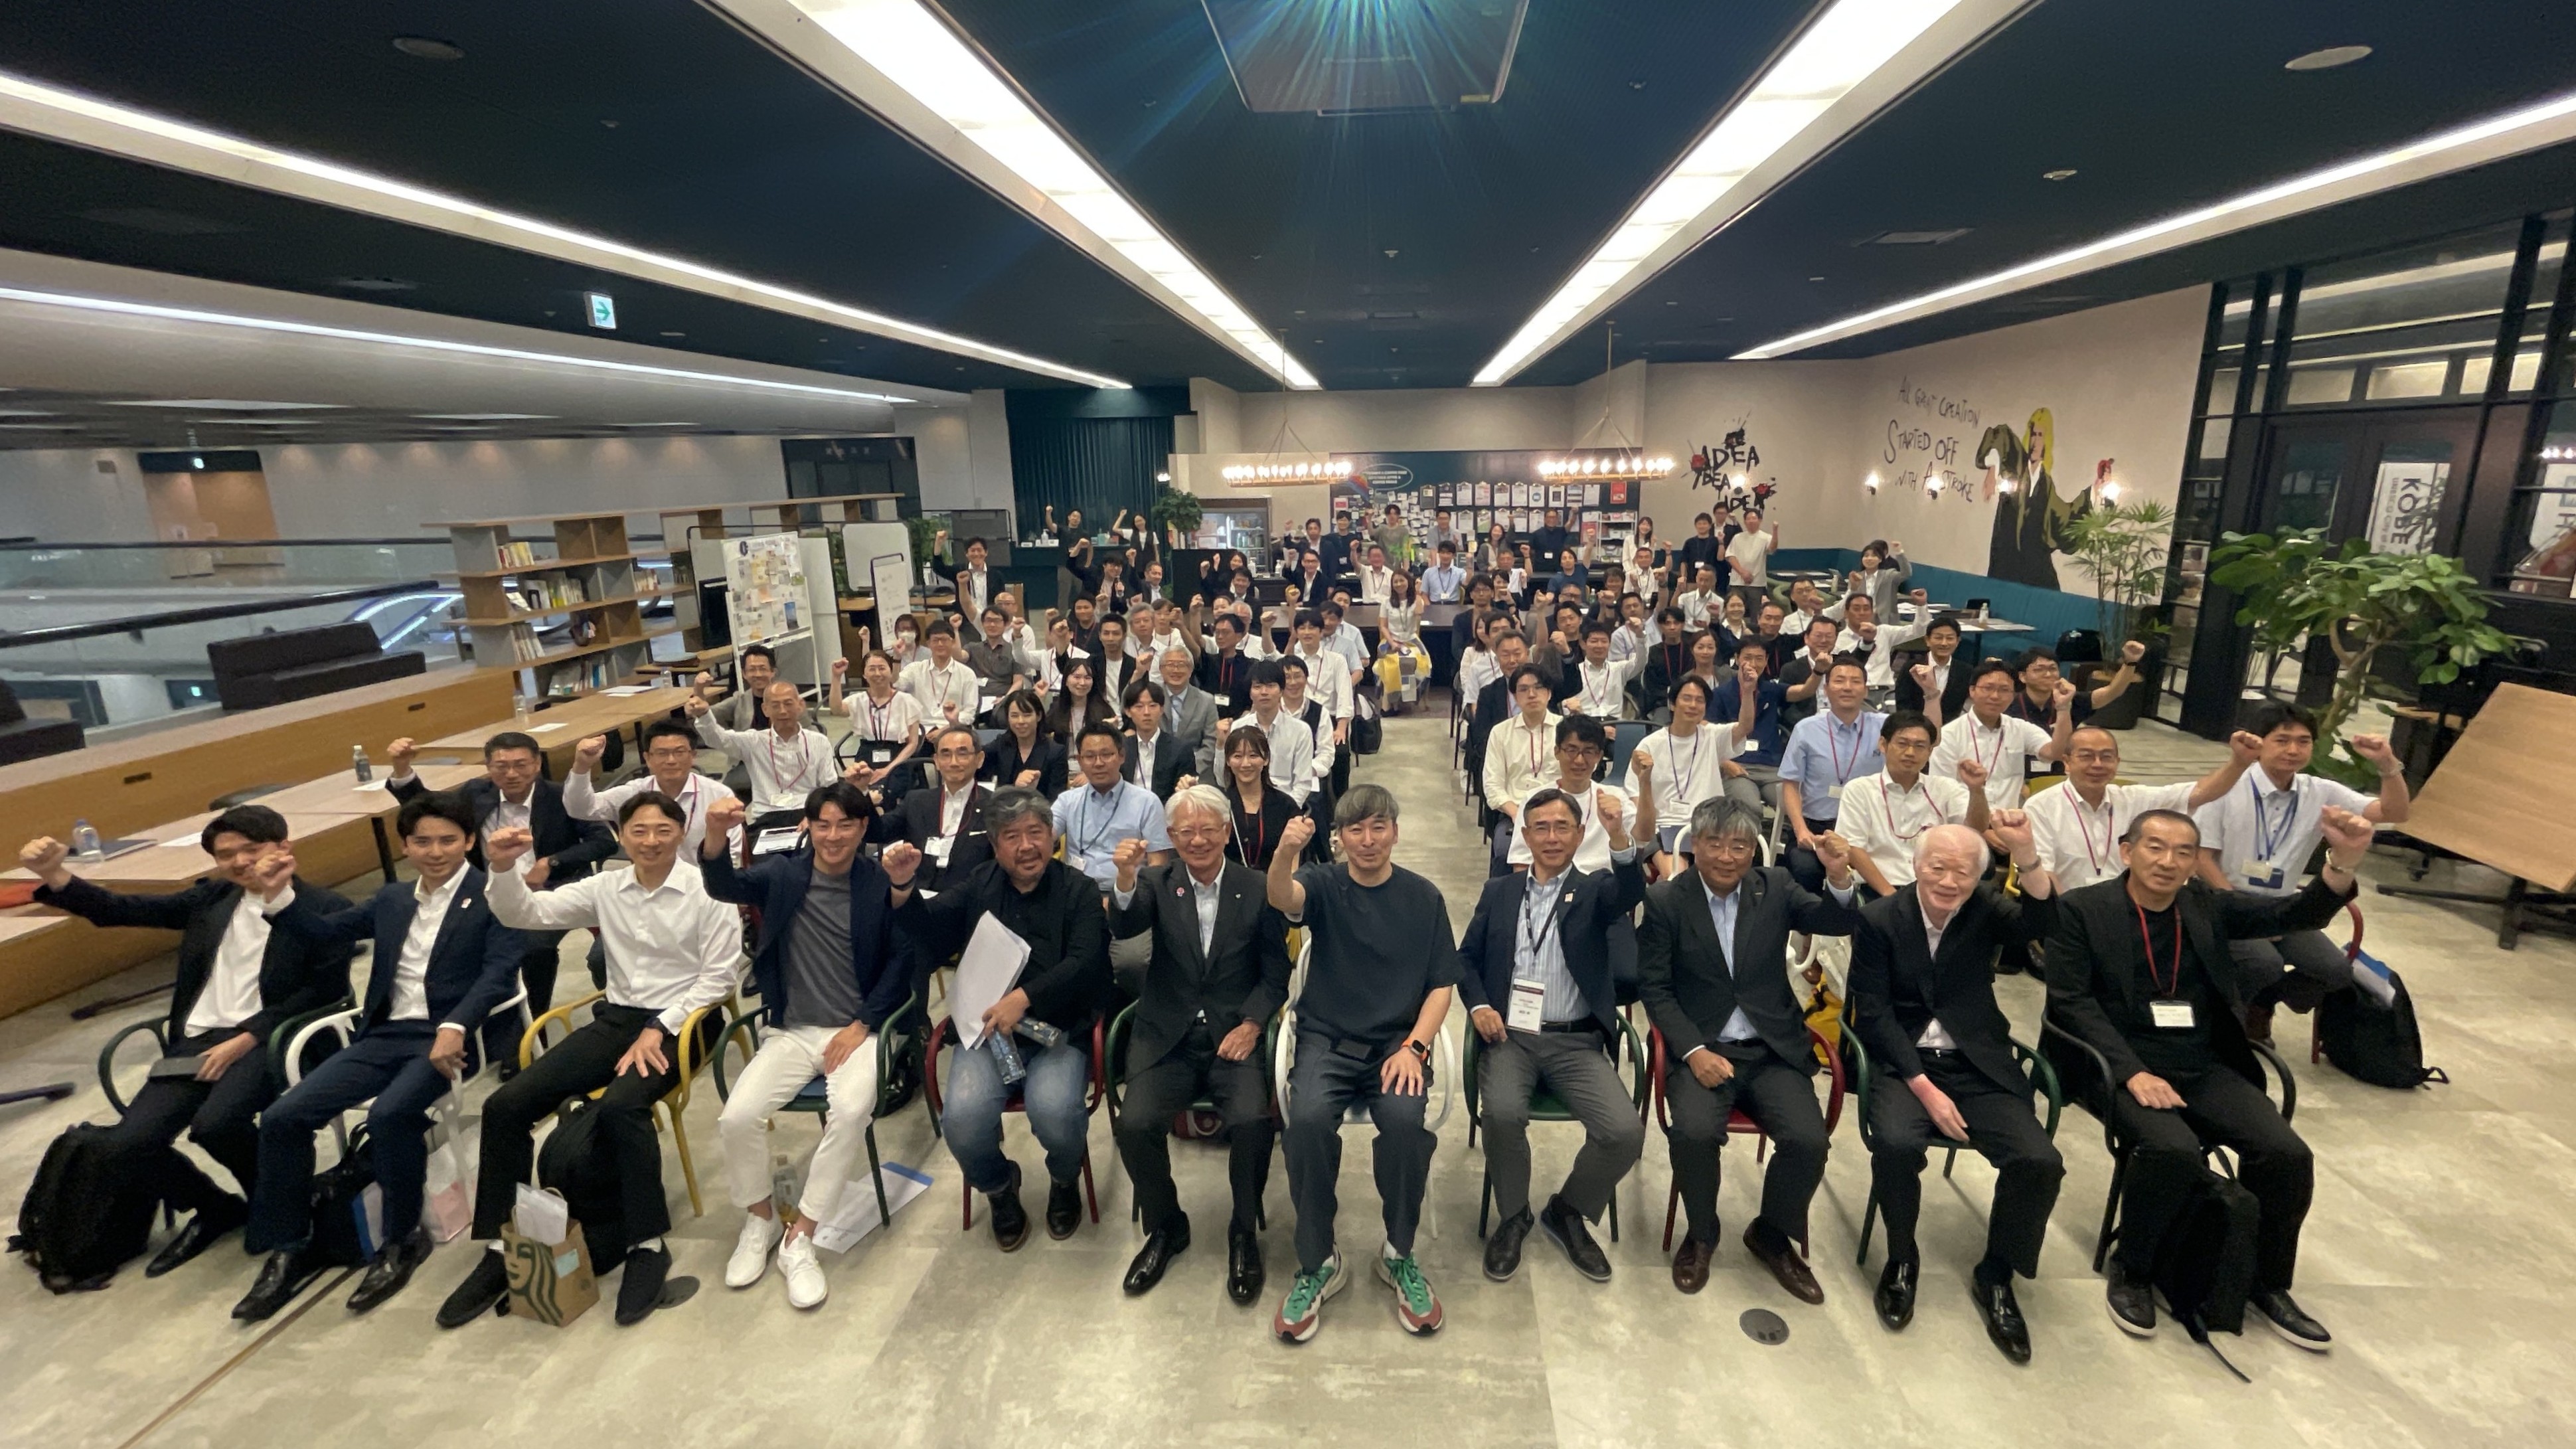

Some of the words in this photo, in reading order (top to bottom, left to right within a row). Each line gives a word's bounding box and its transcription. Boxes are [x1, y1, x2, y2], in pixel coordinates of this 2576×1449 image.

[1884, 419, 1931, 464] STARTED
[1935, 437, 1959, 466] OFF
[2390, 478, 2421, 545] KOBE
